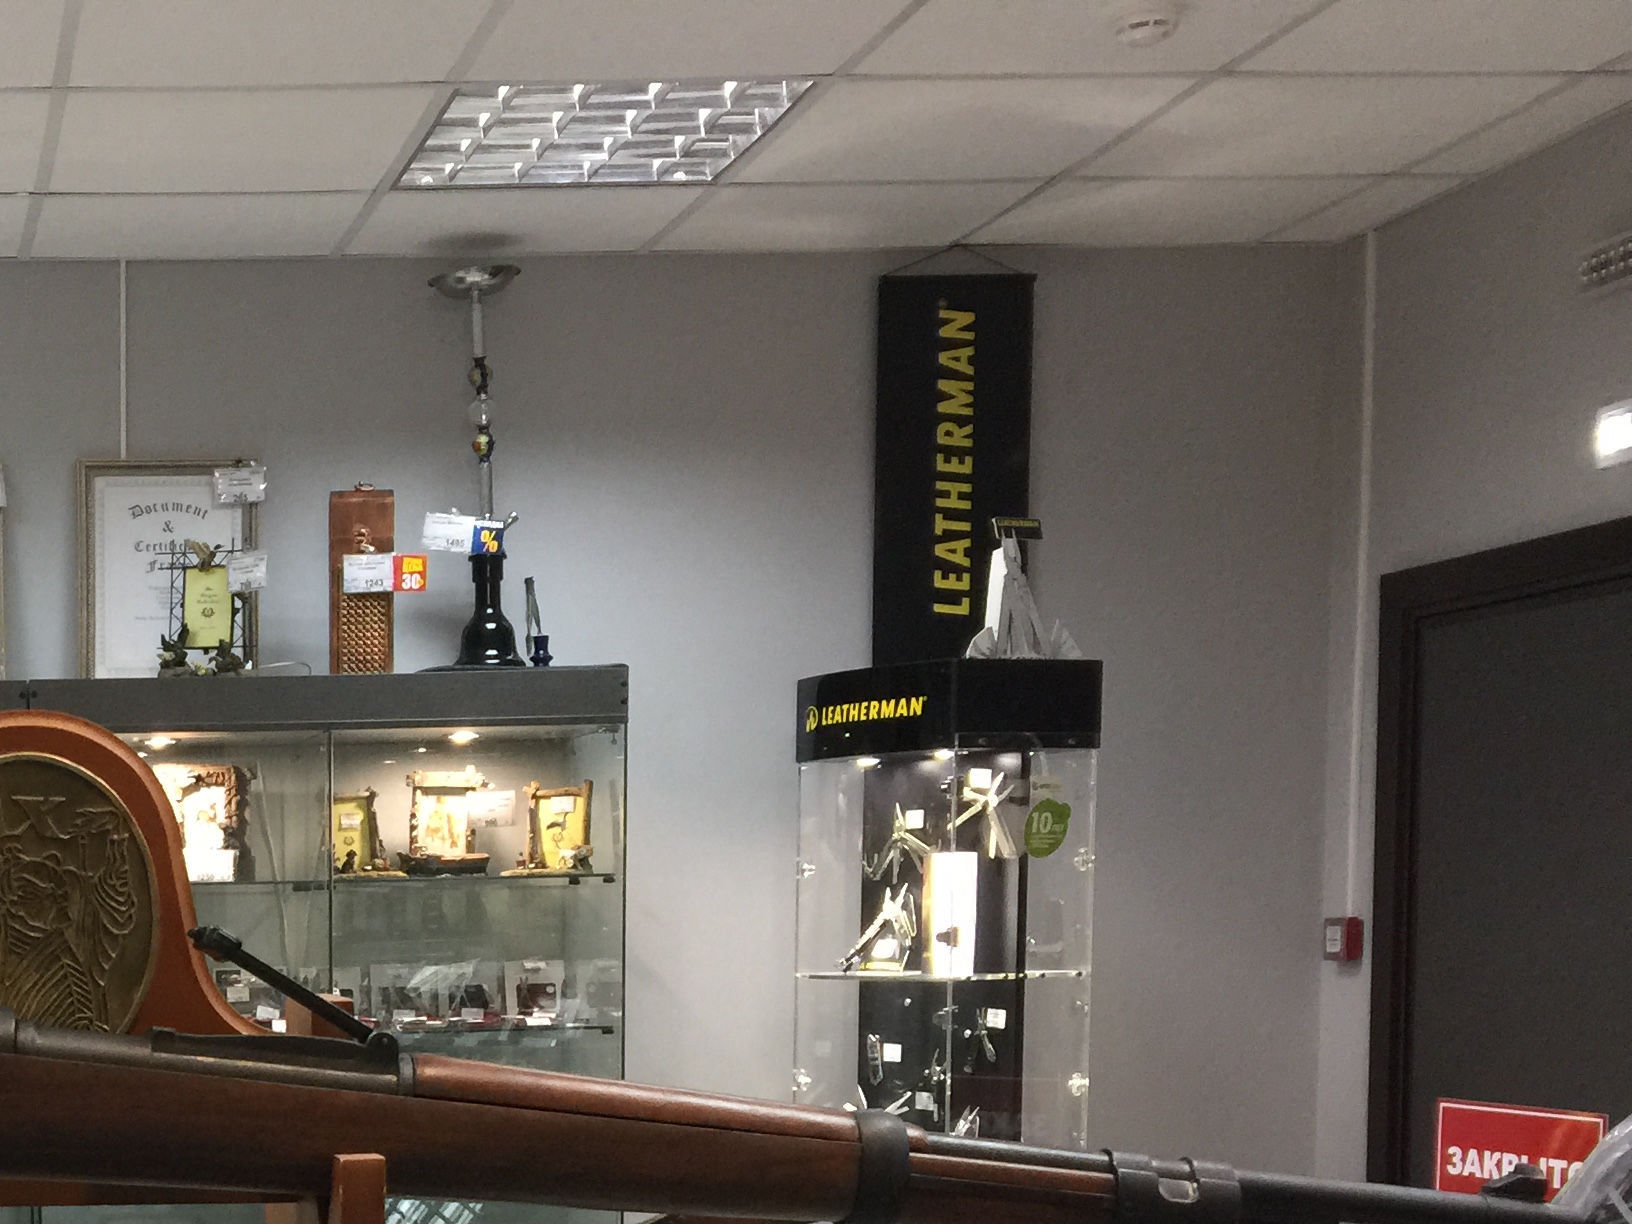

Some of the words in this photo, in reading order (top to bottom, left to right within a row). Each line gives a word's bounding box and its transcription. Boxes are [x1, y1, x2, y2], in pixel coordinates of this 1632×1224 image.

[933, 307, 976, 616] LEATHERMAN
[128, 501, 208, 520] Document
[162, 519, 174, 533] &
[821, 696, 924, 726] LEATHERMAN
[1032, 811, 1053, 833] 10
